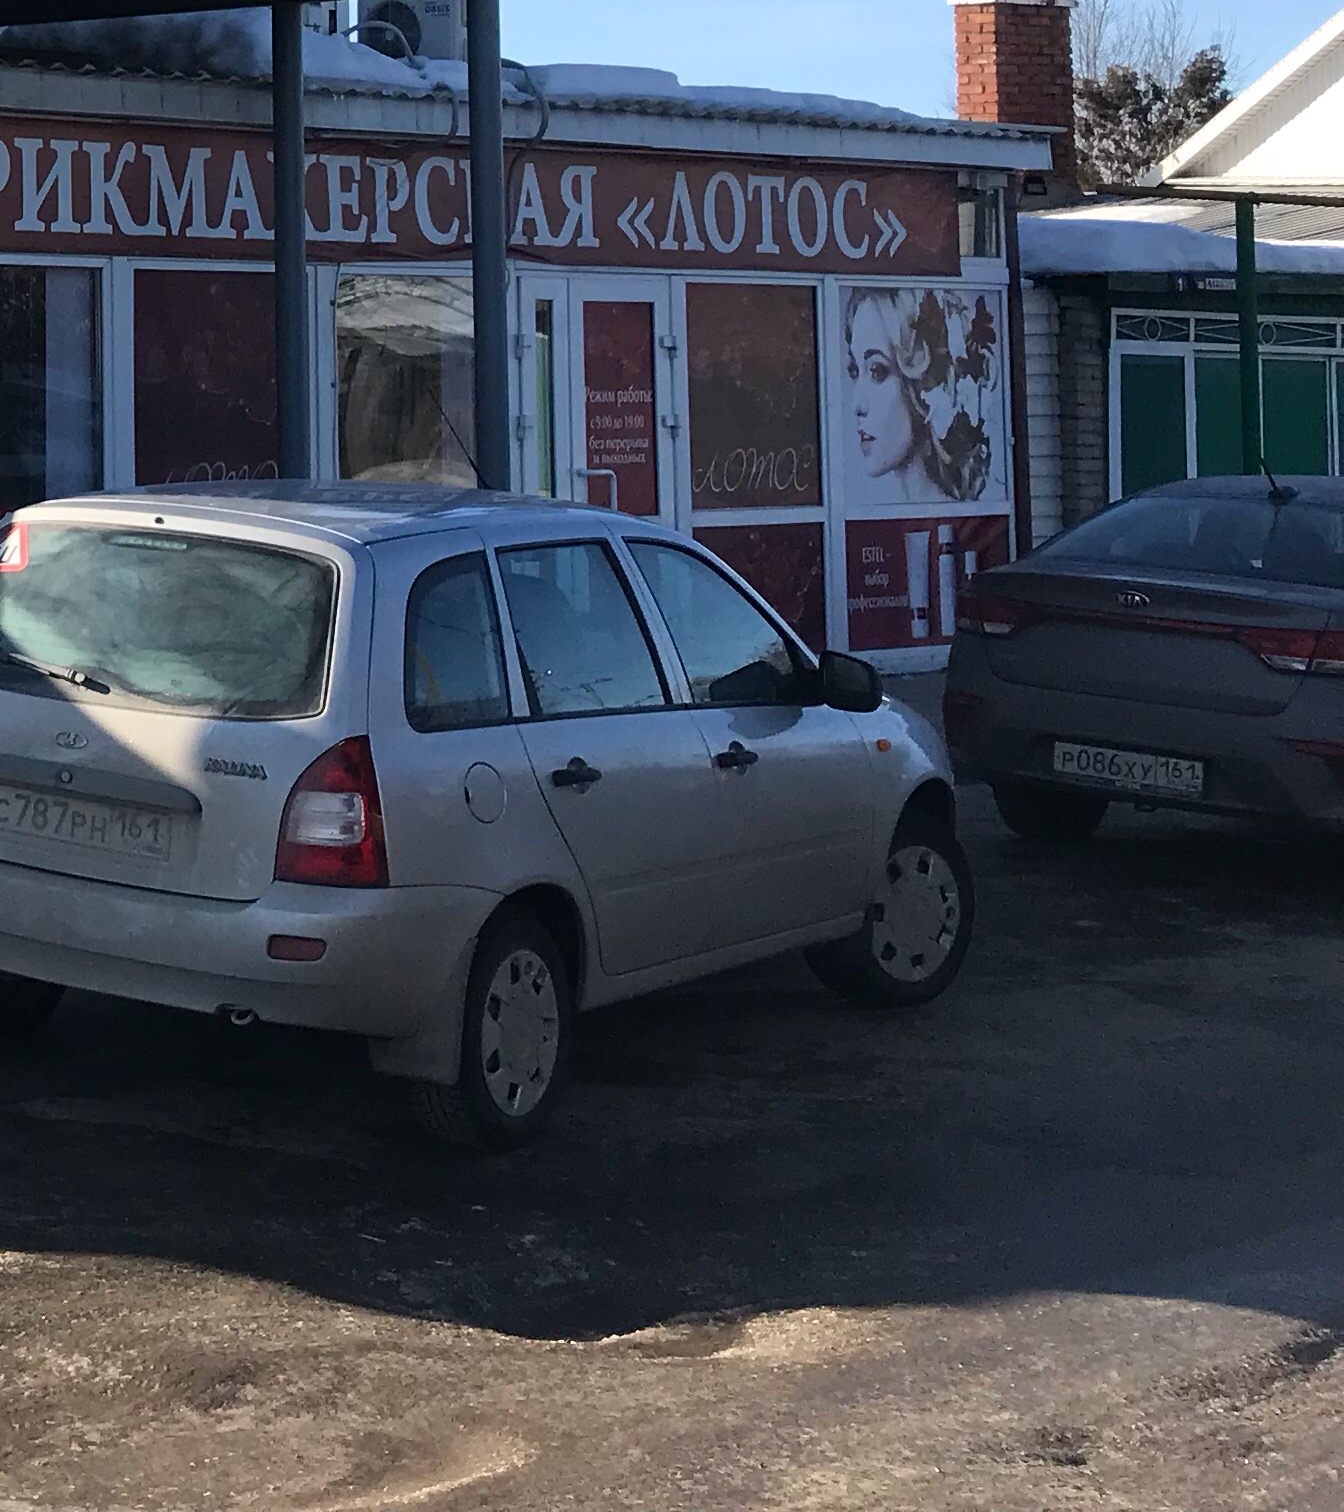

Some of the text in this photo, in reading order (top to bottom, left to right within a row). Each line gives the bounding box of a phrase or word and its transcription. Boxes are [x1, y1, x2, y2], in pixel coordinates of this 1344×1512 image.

[617, 171, 908, 259] «ЛОТОС»
[1116, 593, 1144, 607] KIA
[1159, 759, 1197, 781] 161
[115, 810, 159, 843] 161
